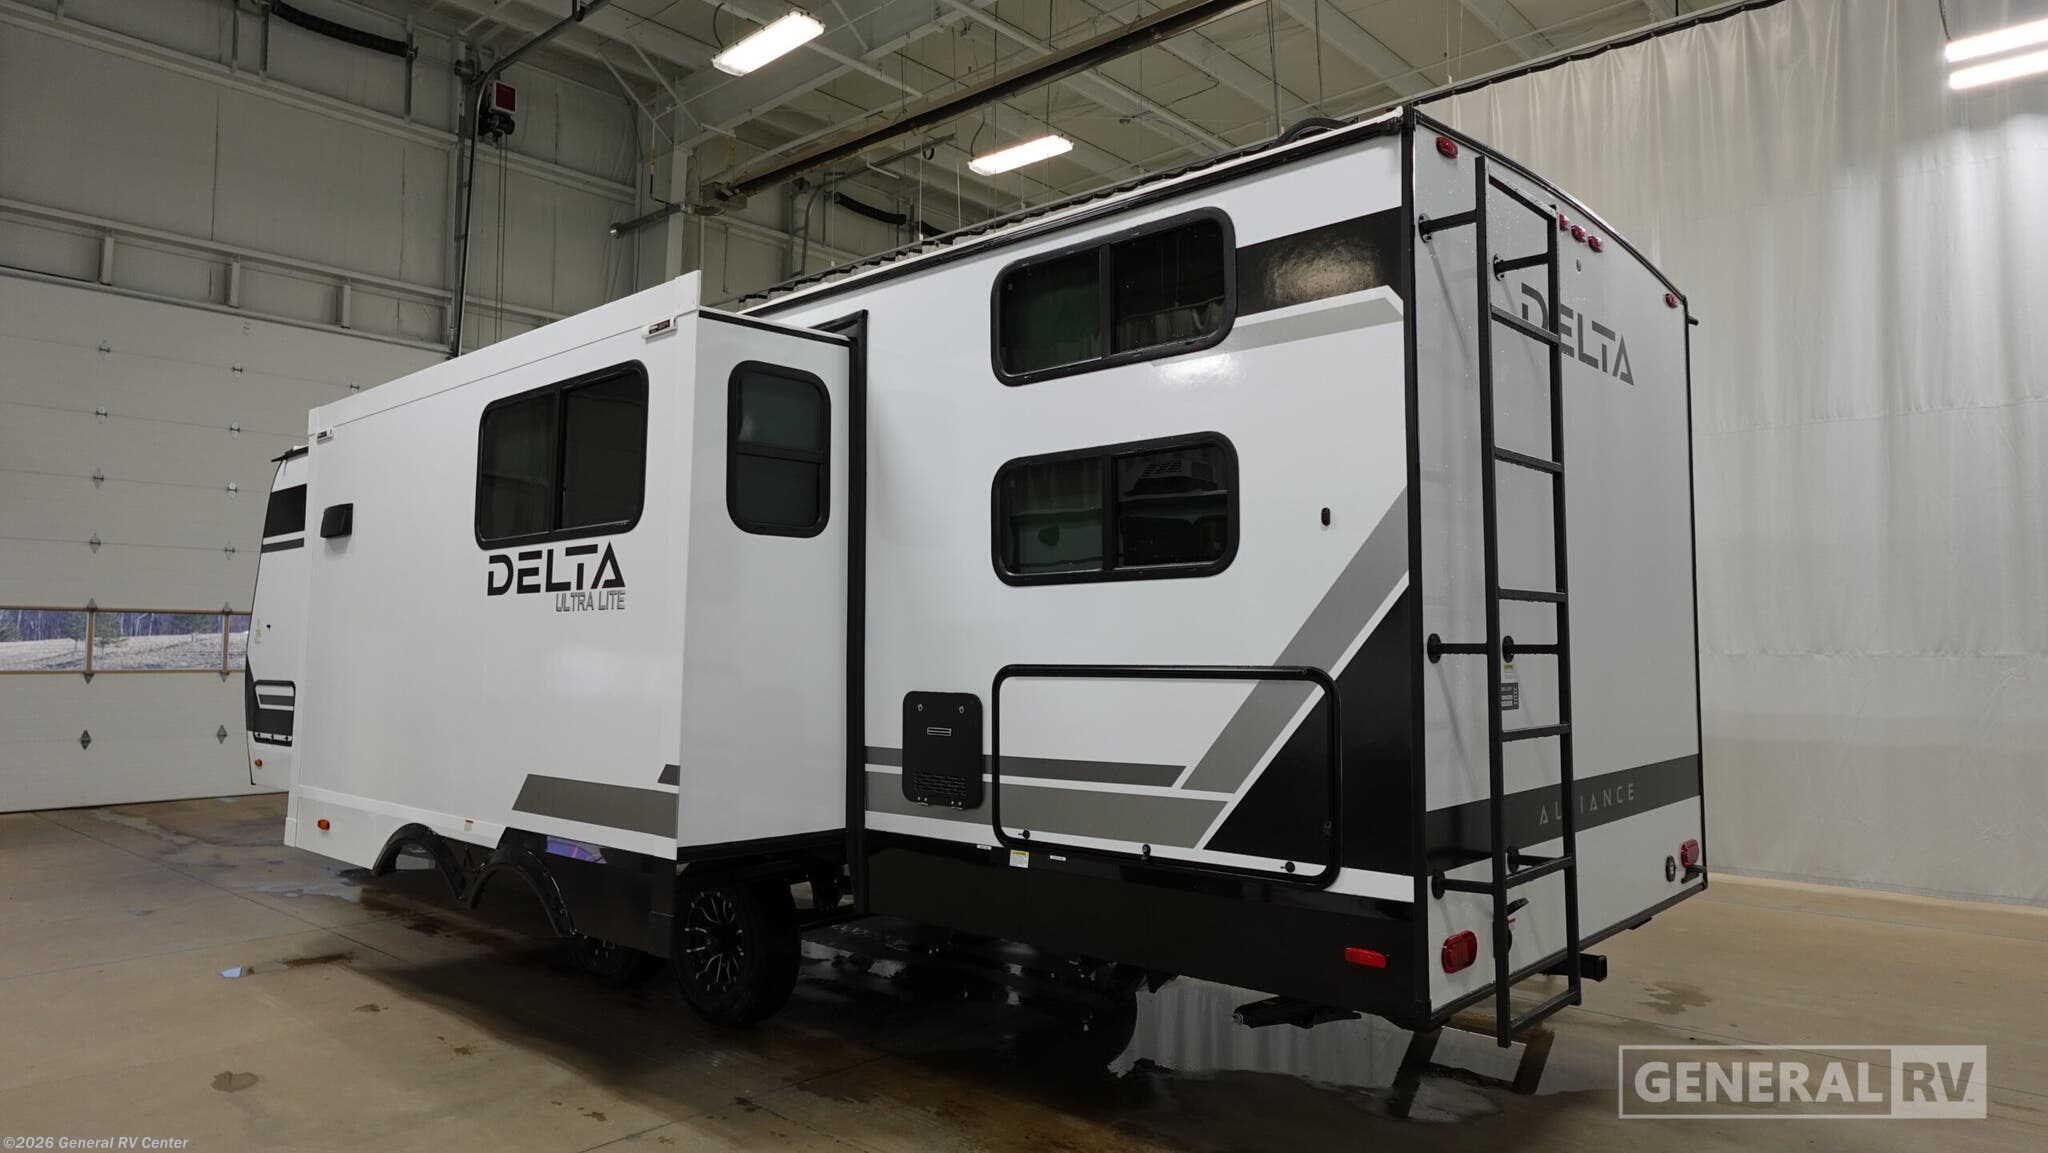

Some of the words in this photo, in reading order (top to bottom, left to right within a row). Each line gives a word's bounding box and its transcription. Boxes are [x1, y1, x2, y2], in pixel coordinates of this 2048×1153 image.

[1521, 282, 1634, 386] DELTA
[487, 541, 625, 596] DELTA
[555, 591, 594, 612] ULTRA
[598, 589, 626, 611] LITE
[1539, 783, 1634, 825] ALIANCE
